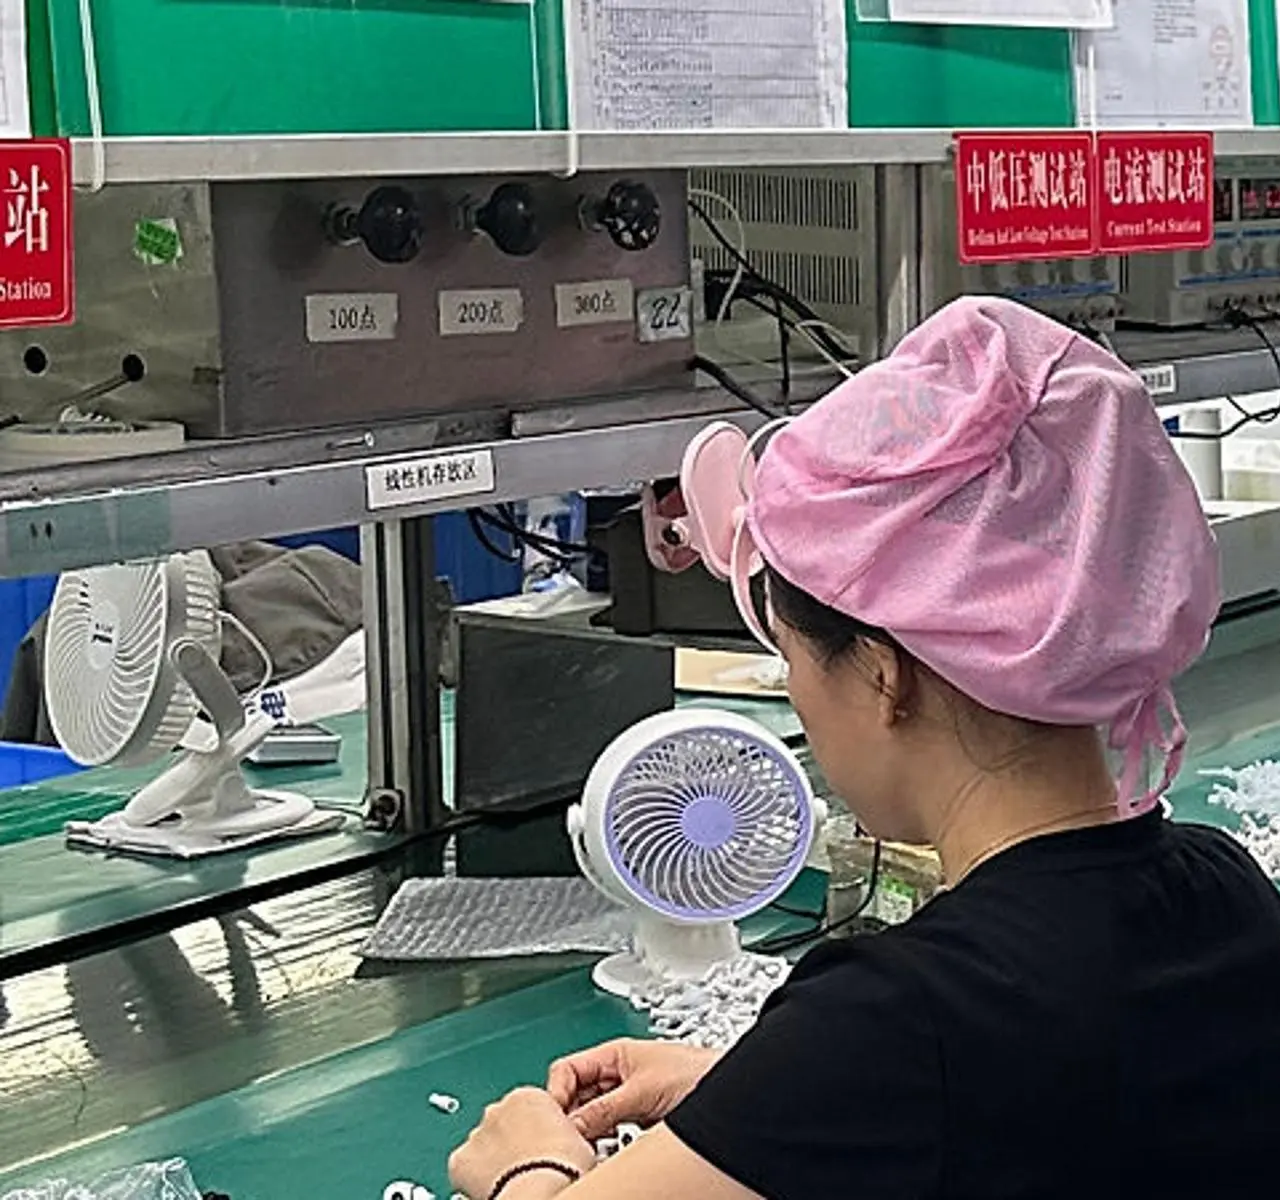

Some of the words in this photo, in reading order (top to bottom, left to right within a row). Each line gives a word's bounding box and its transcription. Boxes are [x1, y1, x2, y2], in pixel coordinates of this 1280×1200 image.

[966, 148, 1088, 213] 中低压测试站
[1103, 146, 1206, 205] 电流测试站
[3, 163, 50, 253] 站
[328, 304, 378, 331] 100点
[457, 301, 504, 325] 200点
